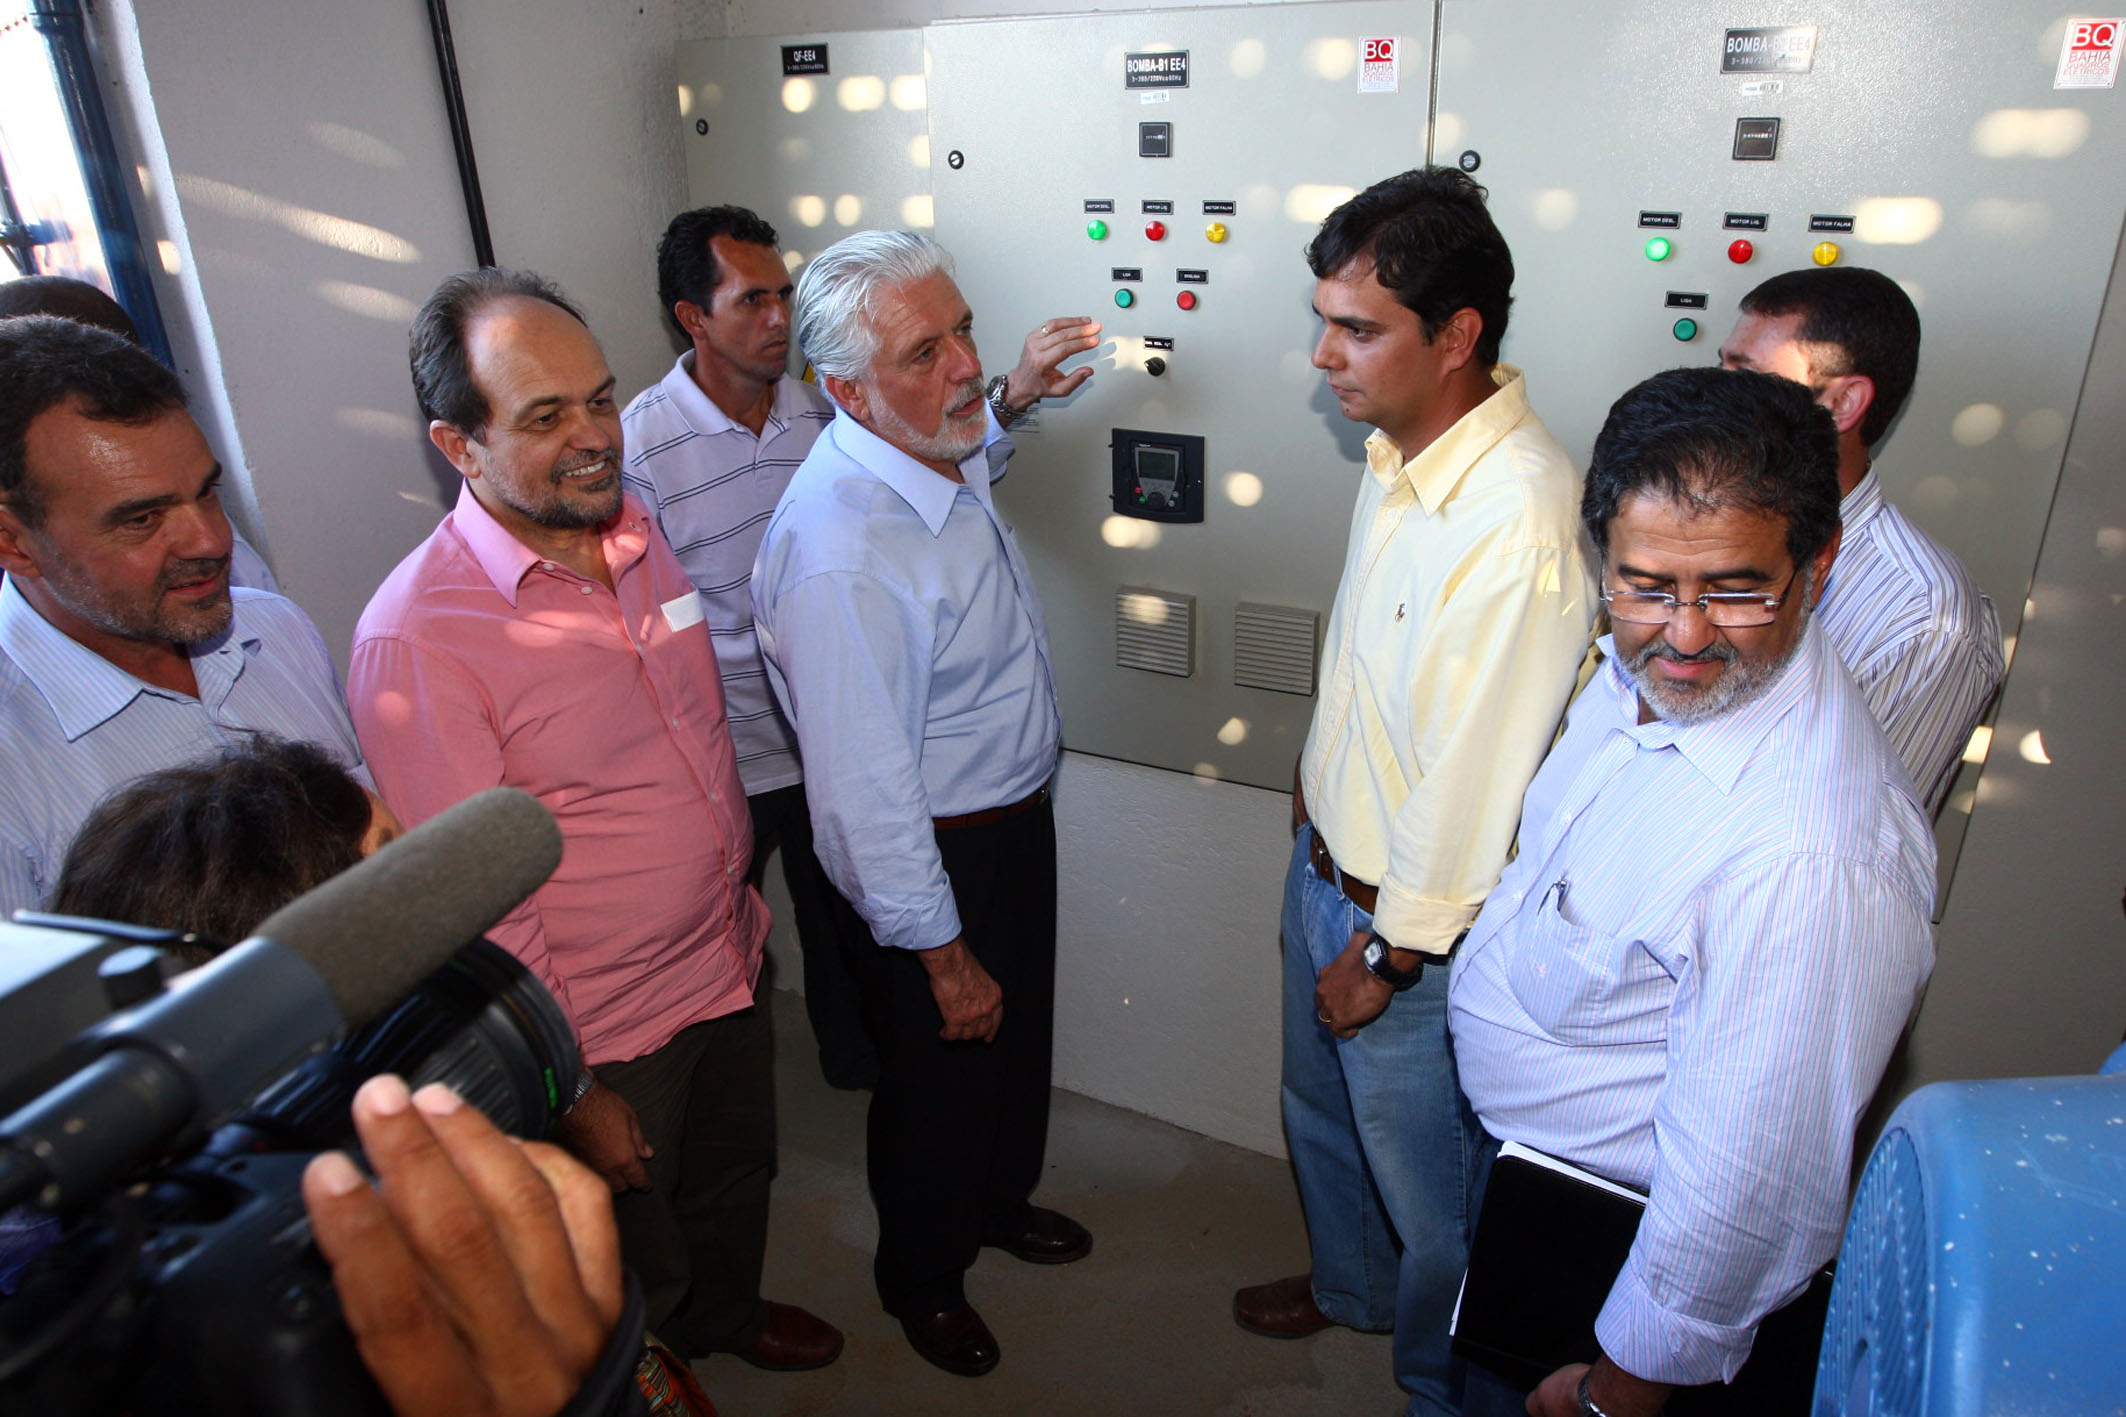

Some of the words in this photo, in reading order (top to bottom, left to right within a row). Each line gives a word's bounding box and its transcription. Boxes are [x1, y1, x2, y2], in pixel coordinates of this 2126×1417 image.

[2072, 24, 2115, 47] BQ
[1365, 41, 1393, 59] BQ
[2069, 51, 2111, 63] BAHIA
[1127, 58, 1168, 73] BOMBA-B1
[1170, 57, 1186, 71] EE4
[1365, 63, 1393, 72] BAHIA
